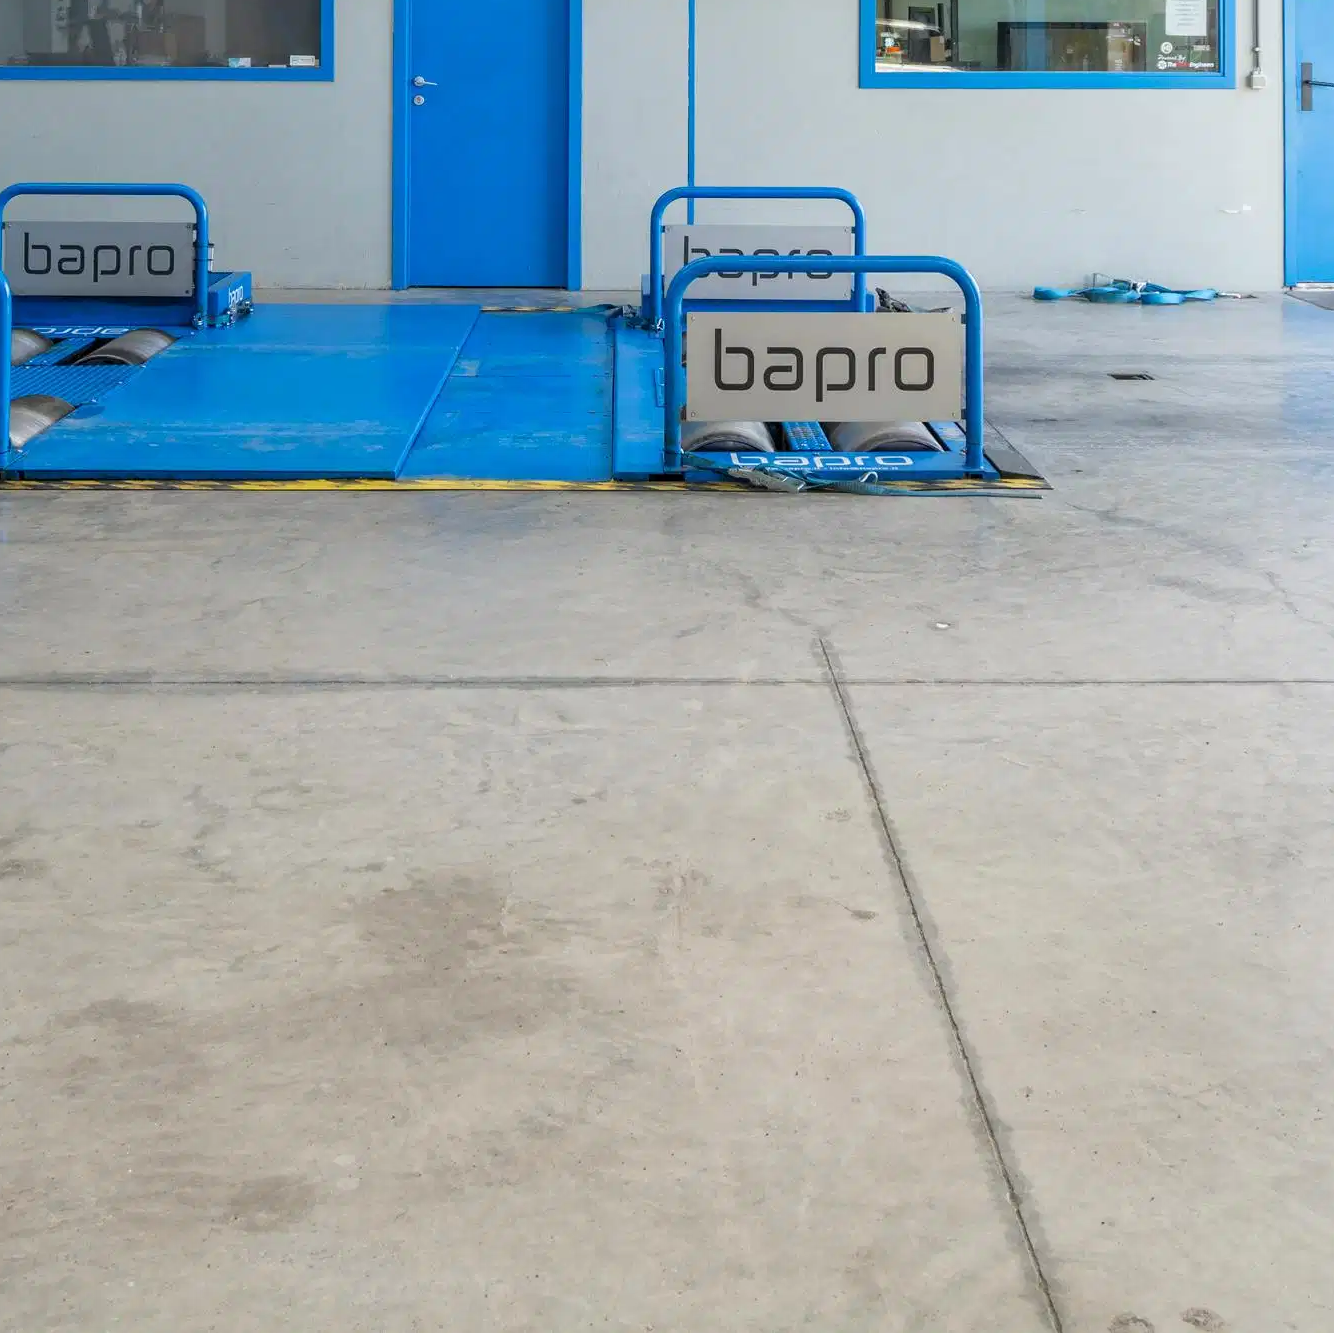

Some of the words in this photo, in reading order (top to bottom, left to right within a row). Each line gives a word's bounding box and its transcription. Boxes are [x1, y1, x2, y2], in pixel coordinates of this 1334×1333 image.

[23, 232, 175, 283] bapro
[714, 328, 935, 403] bapro
[730, 452, 914, 468] bapro
